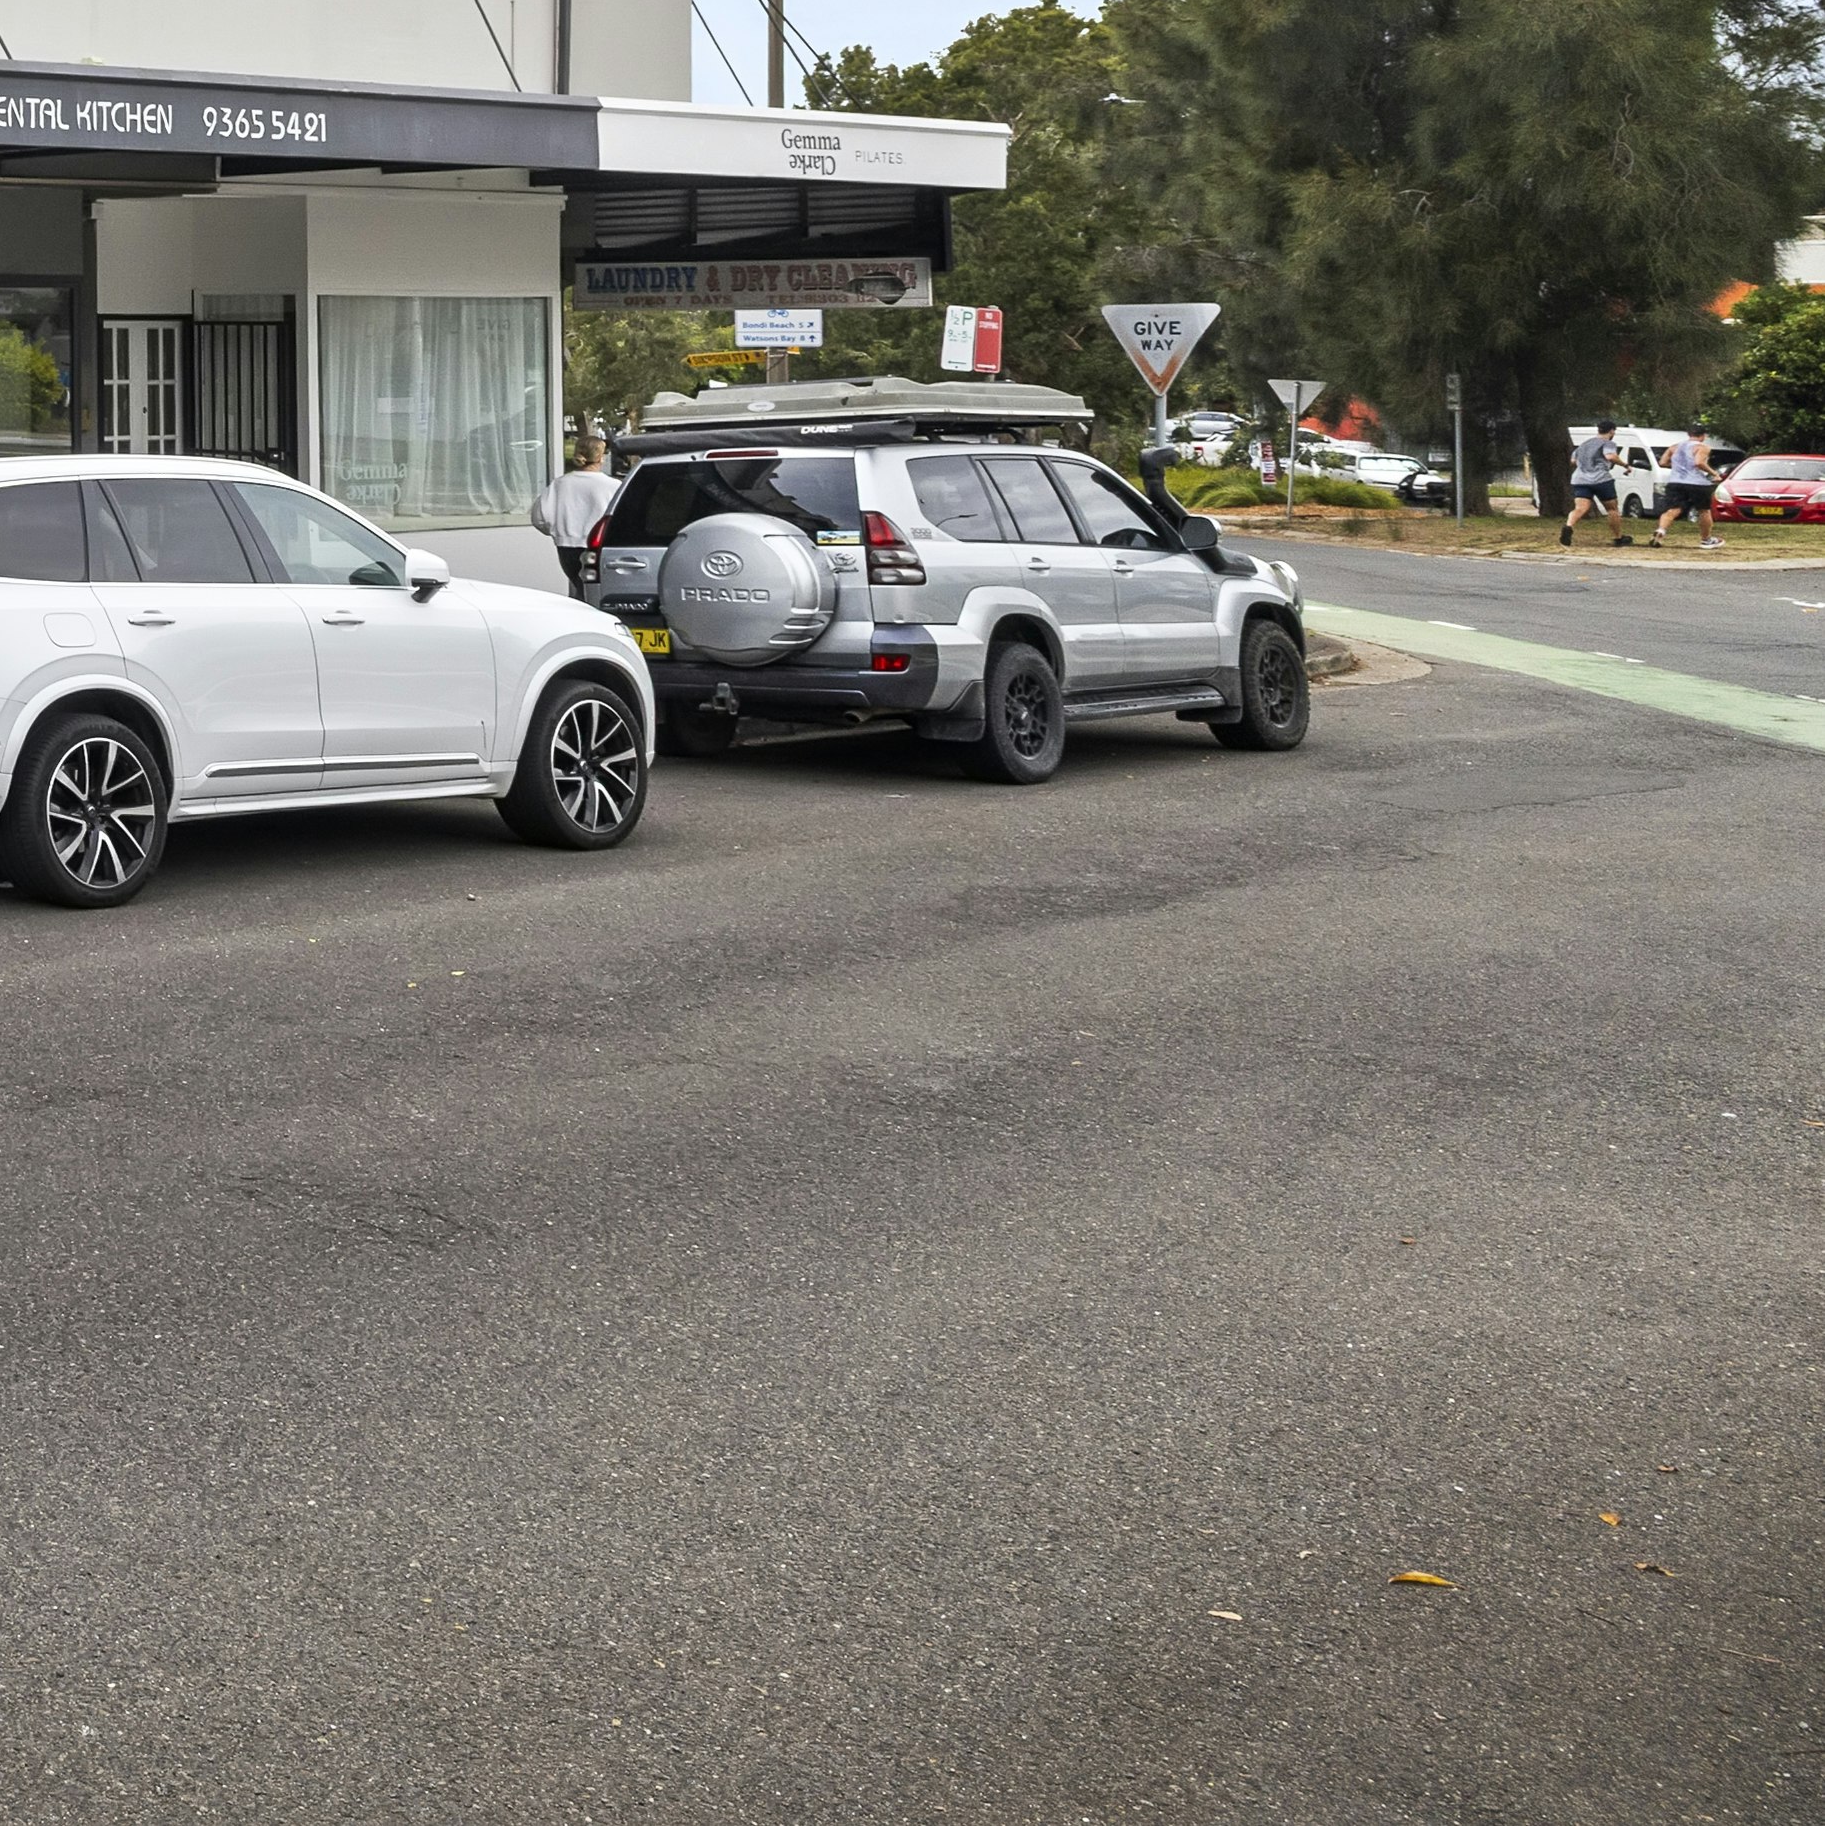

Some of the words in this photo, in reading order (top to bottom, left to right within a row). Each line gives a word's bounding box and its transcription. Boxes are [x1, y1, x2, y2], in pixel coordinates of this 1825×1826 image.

[76, 99, 173, 136] KITCHEN
[203, 106, 266, 140] 9365
[270, 110, 328, 143] 5421
[781, 128, 842, 151] Gemma
[789, 153, 837, 175] Clarke
[586, 266, 698, 293] LAUNDRY
[706, 264, 721, 292] &
[730, 264, 781, 292] DRY
[623, 295, 667, 306] OPEN
[674, 295, 682, 305] 7
[690, 294, 734, 305] DAYS
[742, 321, 768, 329] Bondi
[770, 321, 795, 329] Beach
[1133, 320, 1182, 336] GIVE
[744, 334, 779, 342] Watsons
[781, 334, 796, 343] Bay
[1141, 339, 1174, 351] WAY
[801, 425, 838, 435] DUNE
[681, 587, 771, 604] PRADO
